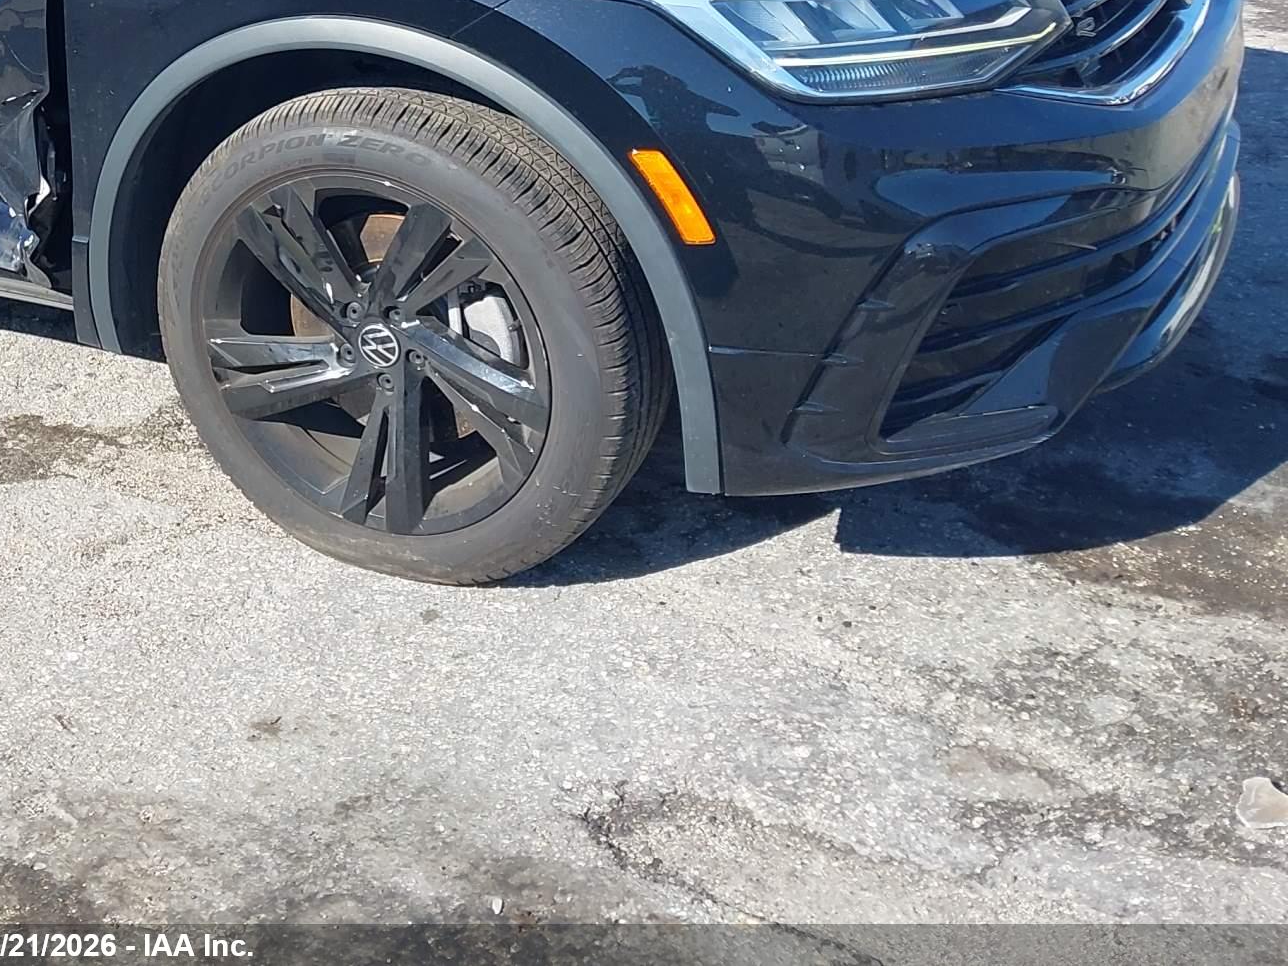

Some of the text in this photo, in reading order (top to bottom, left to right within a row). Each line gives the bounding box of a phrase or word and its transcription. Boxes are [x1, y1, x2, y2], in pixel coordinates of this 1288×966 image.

[196, 133, 434, 206] CORPION ZERO
[358, 324, 399, 367] VW
